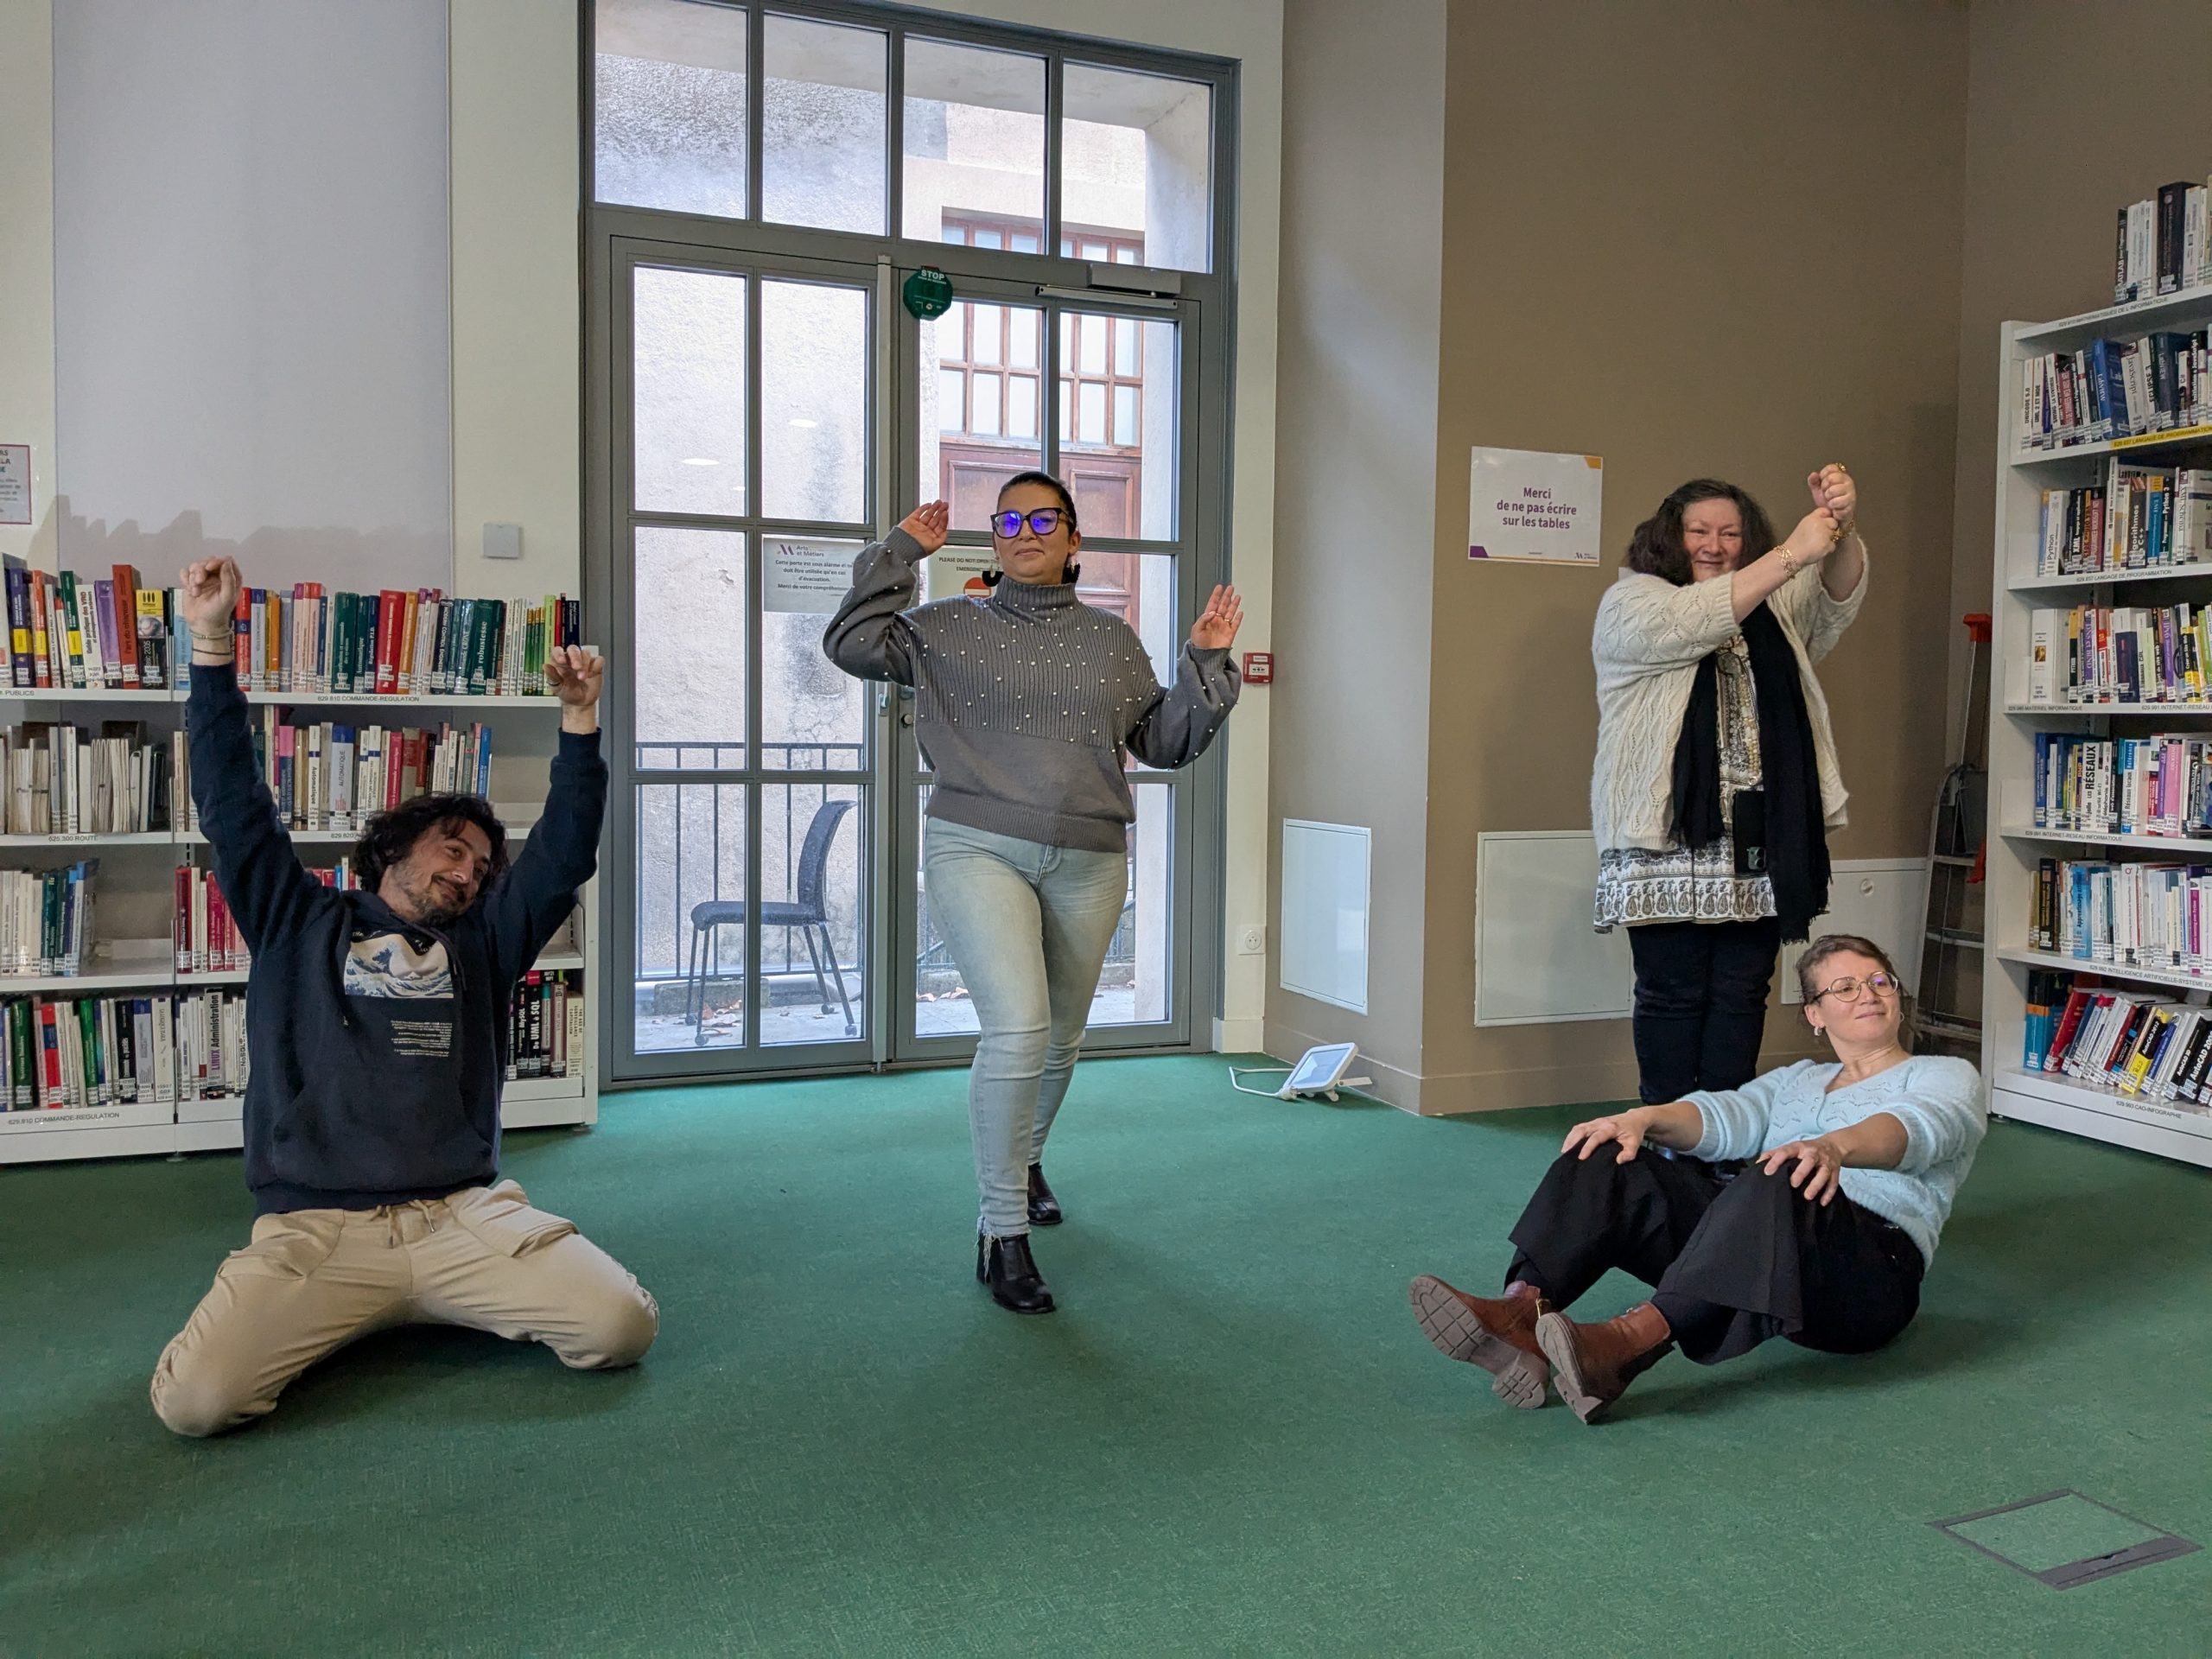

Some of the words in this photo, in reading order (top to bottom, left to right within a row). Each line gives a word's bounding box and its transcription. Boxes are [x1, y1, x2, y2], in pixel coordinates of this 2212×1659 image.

[921, 270, 944, 280] STOP
[2127, 357, 2137, 394] JavaScript
[2097, 374, 2105, 401] LabVIEW
[2133, 436, 2157, 444] LANGAGE
[1523, 487, 1552, 499] Merci
[1497, 500, 1509, 511] de
[1512, 502, 1524, 512] ne
[1527, 504, 1545, 514] pas
[1547, 502, 1576, 515] écrire
[1503, 517, 1519, 526] sur
[1522, 516, 1536, 527] les
[1538, 518, 1570, 529] tables
[2127, 570, 2172, 578] PROGRAMMATION
[82, 616, 92, 638] pratique
[477, 621, 488, 663] robustesse
[2083, 746, 2096, 789] RÉSEAUX
[2108, 968, 2143, 977] INTELLIGENCE
[2144, 974, 2203, 987] ARTIFICIELLE-SYSTEME
[530, 1000, 540, 1015] SQL
[211, 995, 220, 1047] Administration
[530, 1022, 539, 1040] UML
[2140, 1032, 2156, 1055] AutoCAD
[2150, 1021, 2160, 1034] 2012
[211, 1049, 220, 1070] LINUX
[2175, 1056, 2190, 1076] AutoCAD
[2188, 1048, 2210, 1080] AutoCAD
[34, 1112, 120, 1123] COMMANDE-REGULATION
[2135, 1105, 2182, 1119] CAO-INFOGRAPHIE
